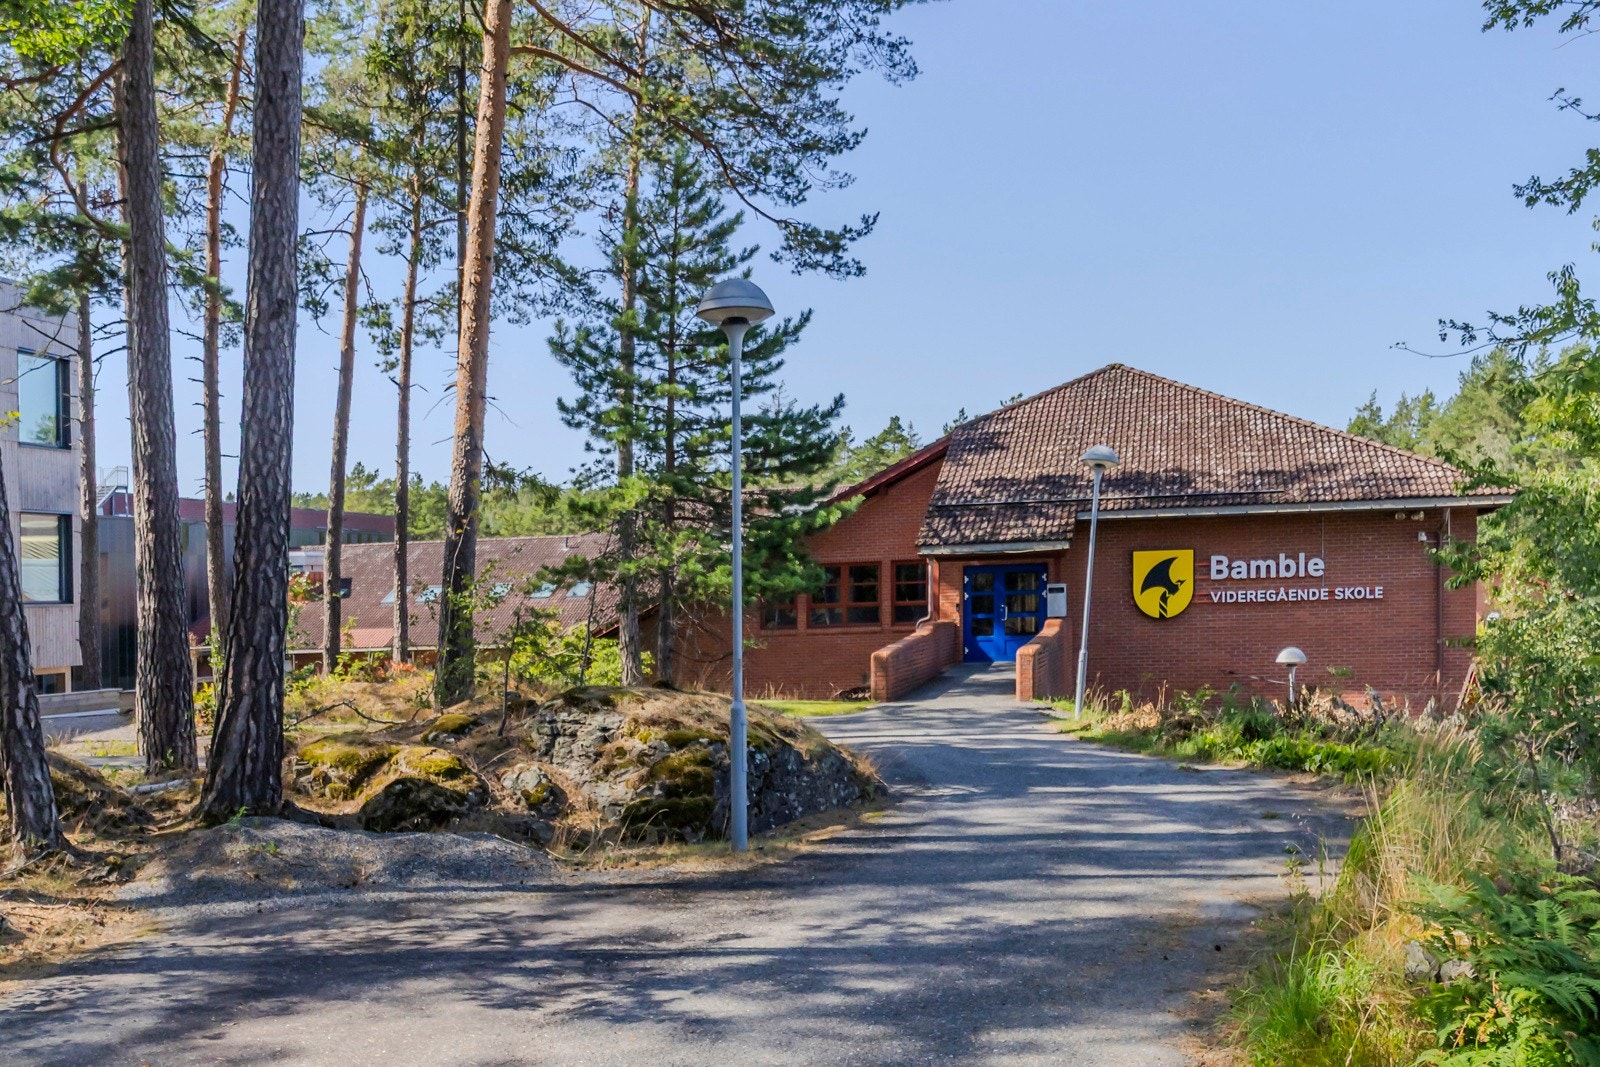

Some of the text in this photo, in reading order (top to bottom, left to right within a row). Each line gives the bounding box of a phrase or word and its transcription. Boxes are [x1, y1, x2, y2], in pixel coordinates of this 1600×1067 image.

[1210, 552, 1325, 580] Bamble
[1210, 586, 1384, 603] VIDEREGÅENDE SKOLE
